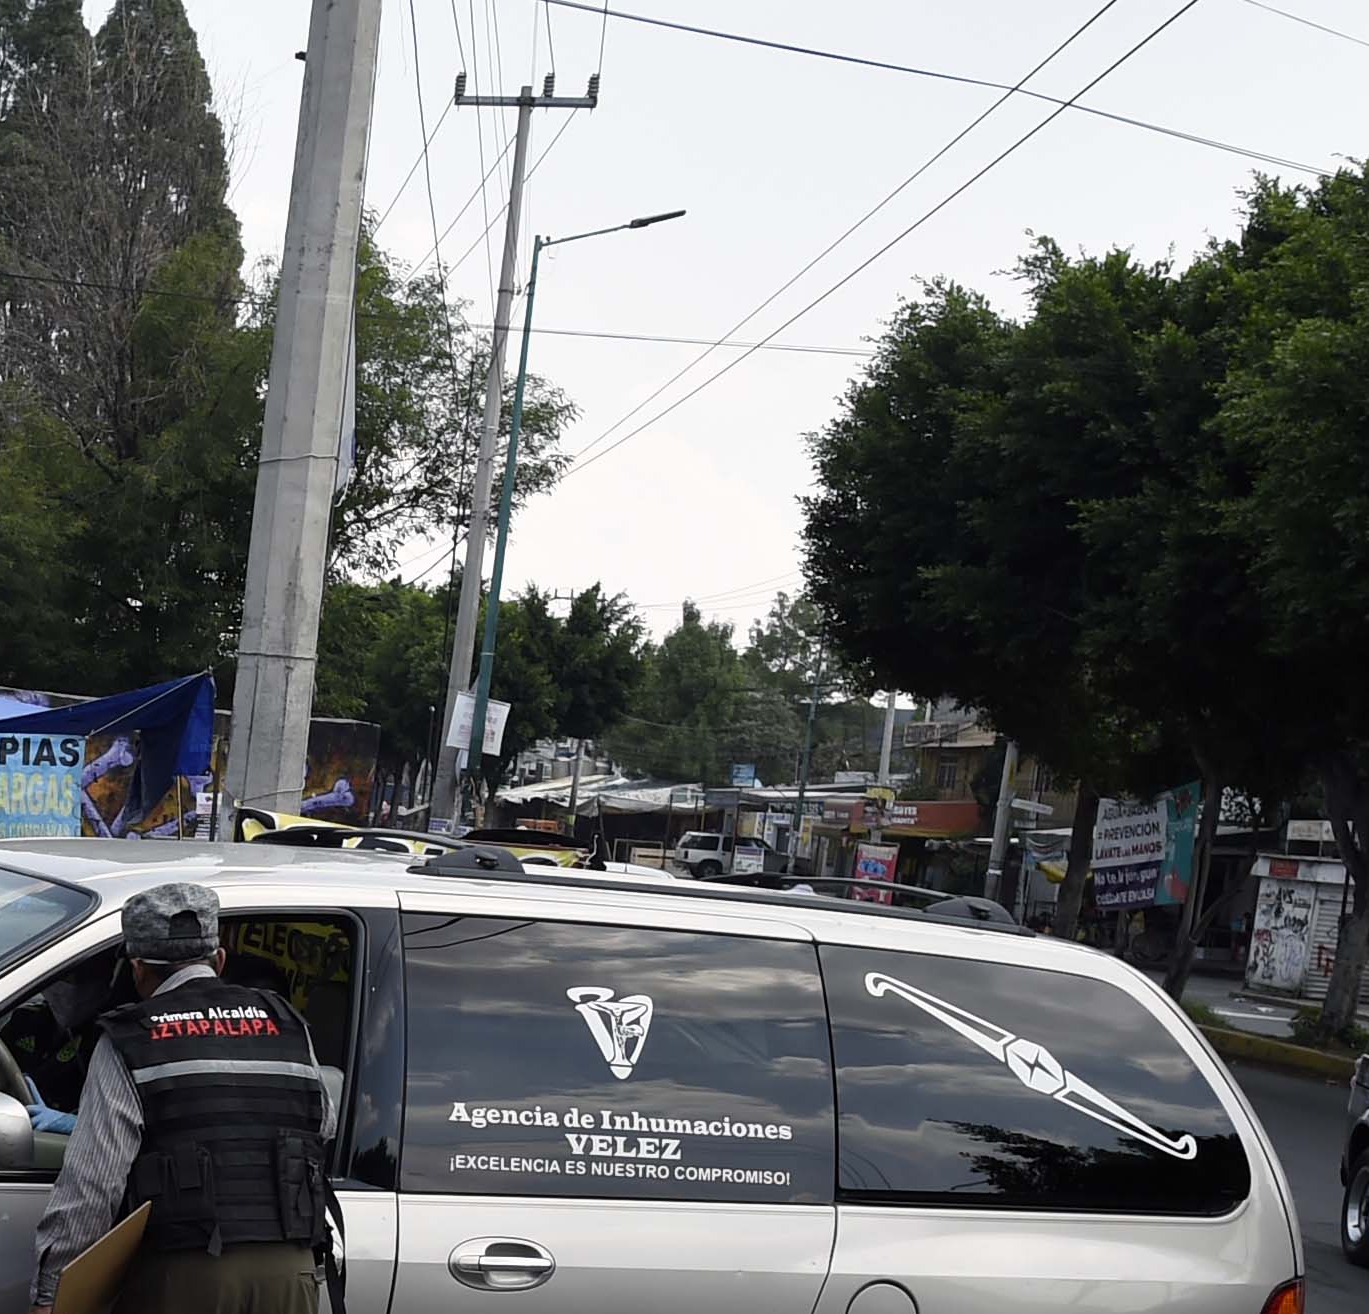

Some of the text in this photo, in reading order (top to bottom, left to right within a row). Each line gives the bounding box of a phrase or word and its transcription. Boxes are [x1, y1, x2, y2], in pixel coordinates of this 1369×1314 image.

[208, 1005, 268, 1019] Alcaldía
[449, 1101, 793, 1140] Agencia de Inhumaciones
[565, 1133, 682, 1160] VELEZ
[450, 1154, 790, 1186] ¡EXCELENCIA ES NUESTRO COMPROMISO!
